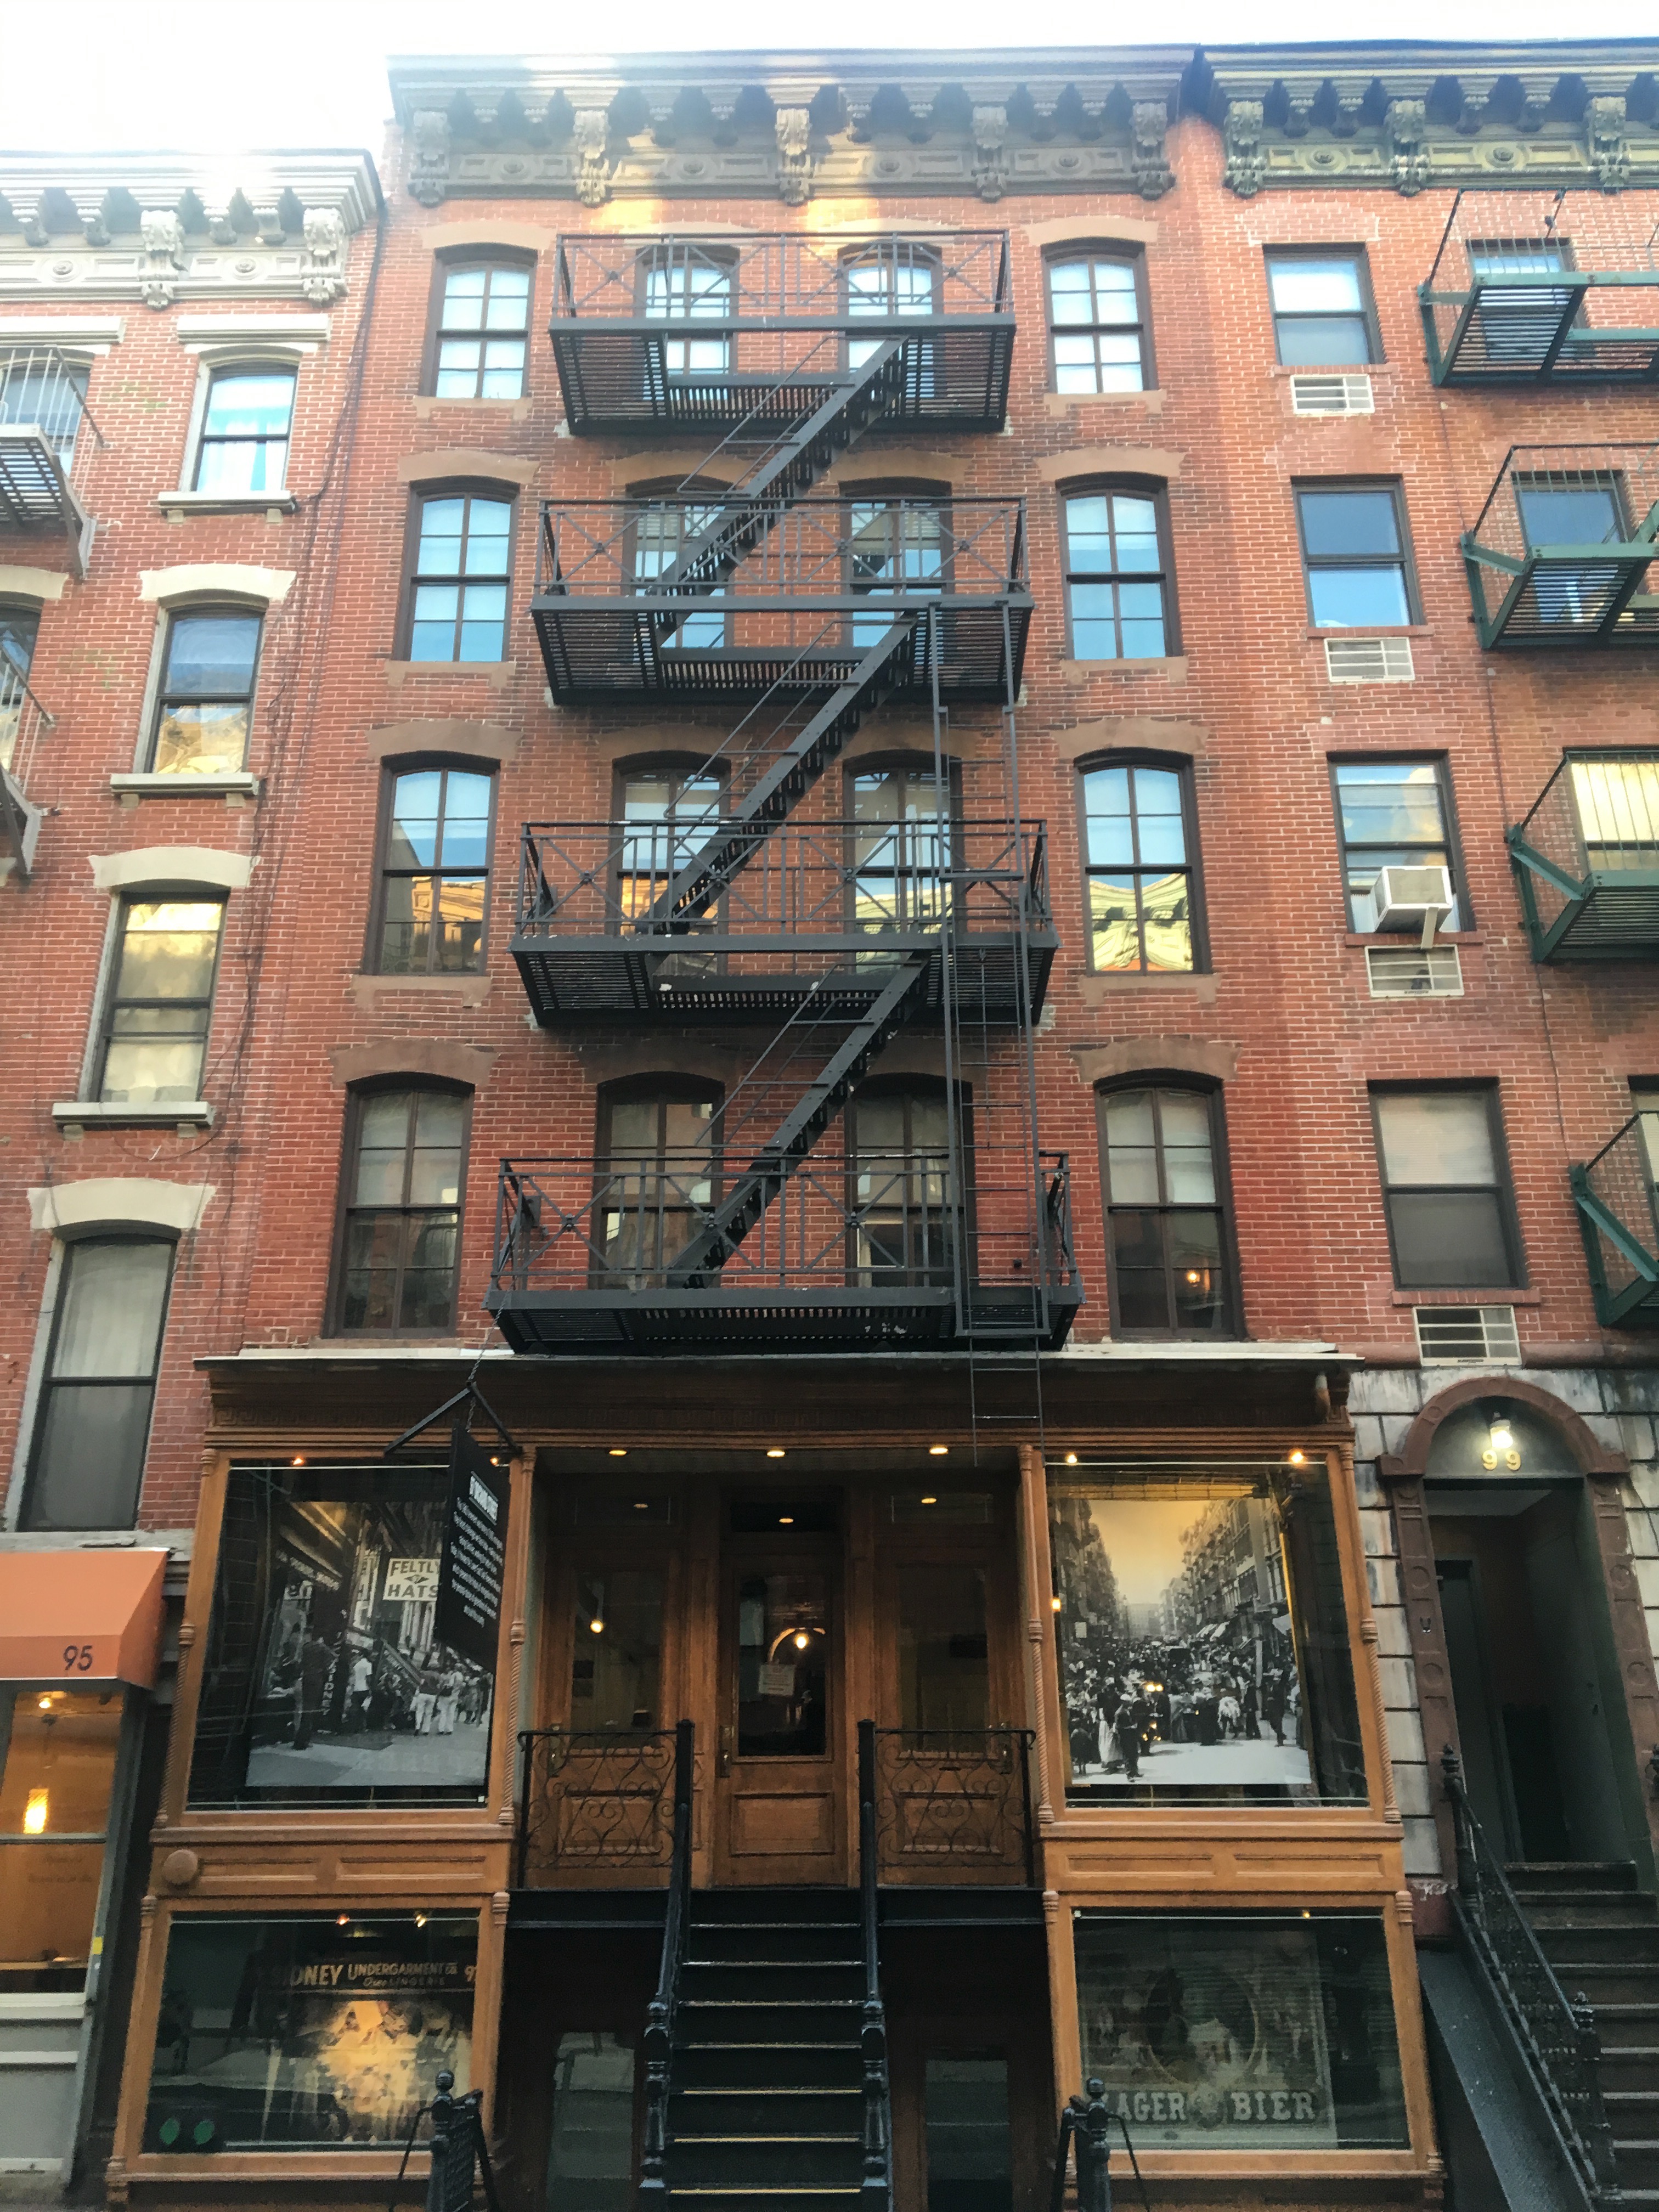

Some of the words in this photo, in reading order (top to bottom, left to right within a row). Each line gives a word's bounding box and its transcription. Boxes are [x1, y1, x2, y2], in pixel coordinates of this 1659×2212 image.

[1482, 1449, 1521, 1472] 99
[388, 1584, 438, 1598] HATS
[63, 1645, 93, 1671] 95
[1102, 2091, 1187, 2121] AGER
[1231, 2092, 1316, 2121] BIER
